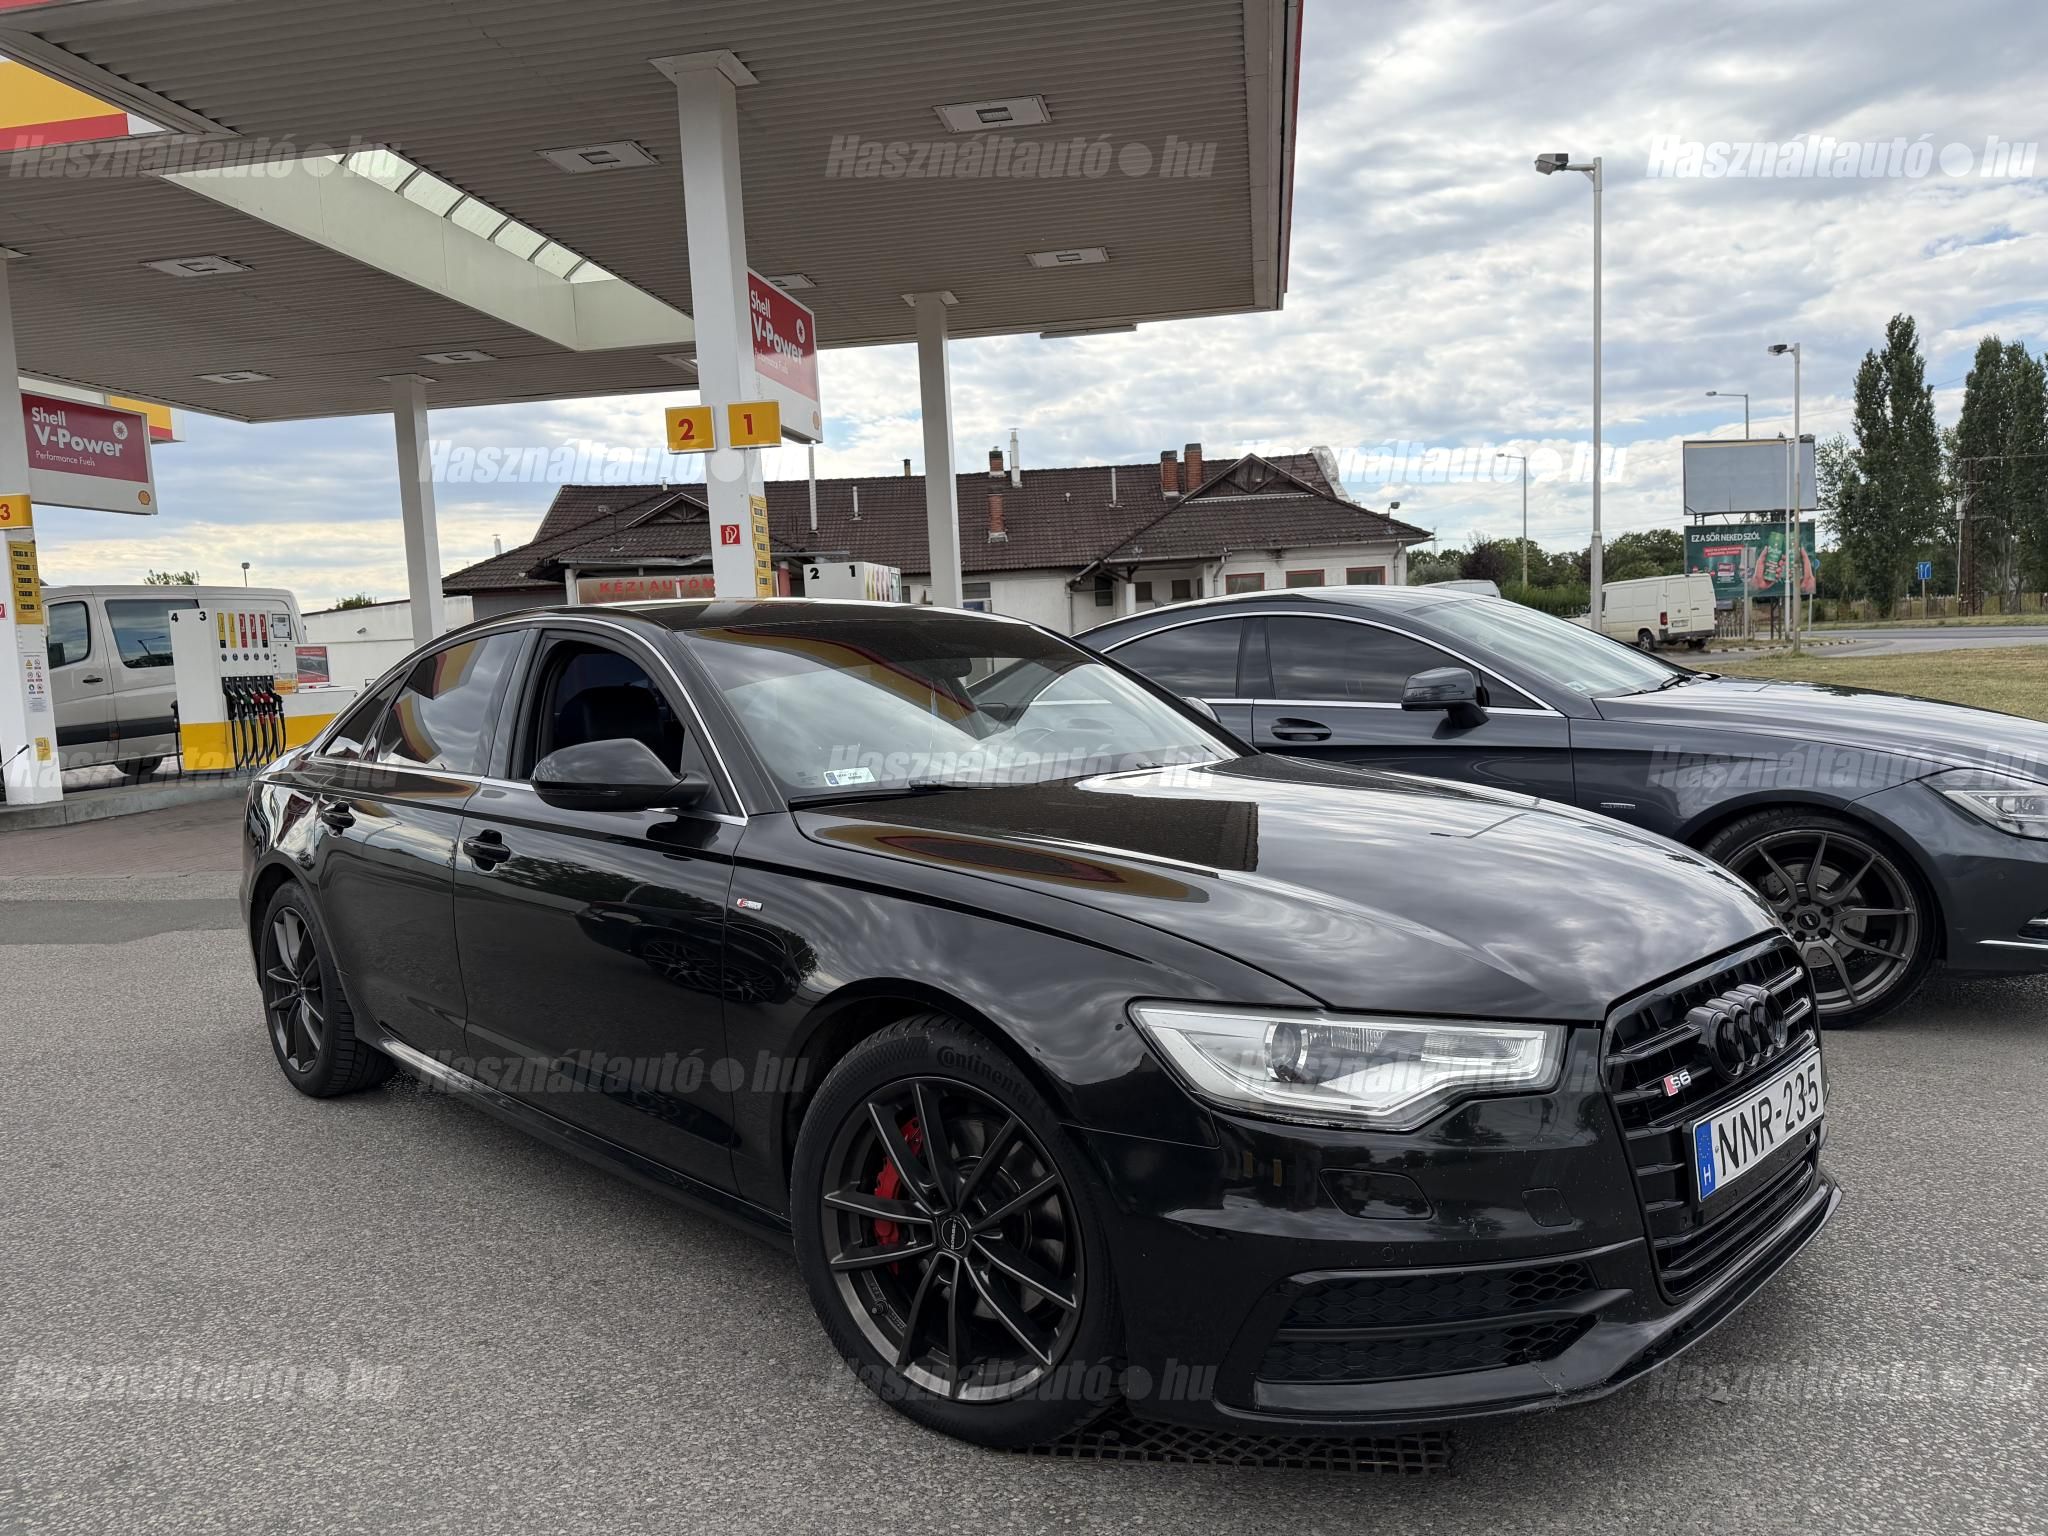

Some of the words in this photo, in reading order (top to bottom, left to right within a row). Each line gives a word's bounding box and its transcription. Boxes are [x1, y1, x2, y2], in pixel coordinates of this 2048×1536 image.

[750, 290, 771, 318] Shell
[752, 313, 804, 365] V-Power
[31, 406, 66, 426] Shell
[743, 414, 753, 435] 1
[678, 418, 695, 441] 2
[33, 423, 122, 456] V-Power
[35, 450, 78, 464] Performance
[79, 456, 95, 467] Fuels
[0, 503, 10, 521] 3
[1691, 534, 1700, 543] EZ
[1701, 534, 1706, 542] A
[1721, 533, 1743, 542] NEKED
[1743, 531, 1761, 541] SZÓL
[810, 567, 820, 580] 2
[849, 565, 856, 578] 1
[600, 579, 644, 593] KÉZI
[171, 612, 179, 623] 4
[199, 611, 207, 621] 3
[937, 1045, 1036, 1107] Continental
[1670, 1070, 1692, 1088] S6
[1716, 1062, 1820, 1177] NNR-235
[1703, 1166, 1712, 1183] H
